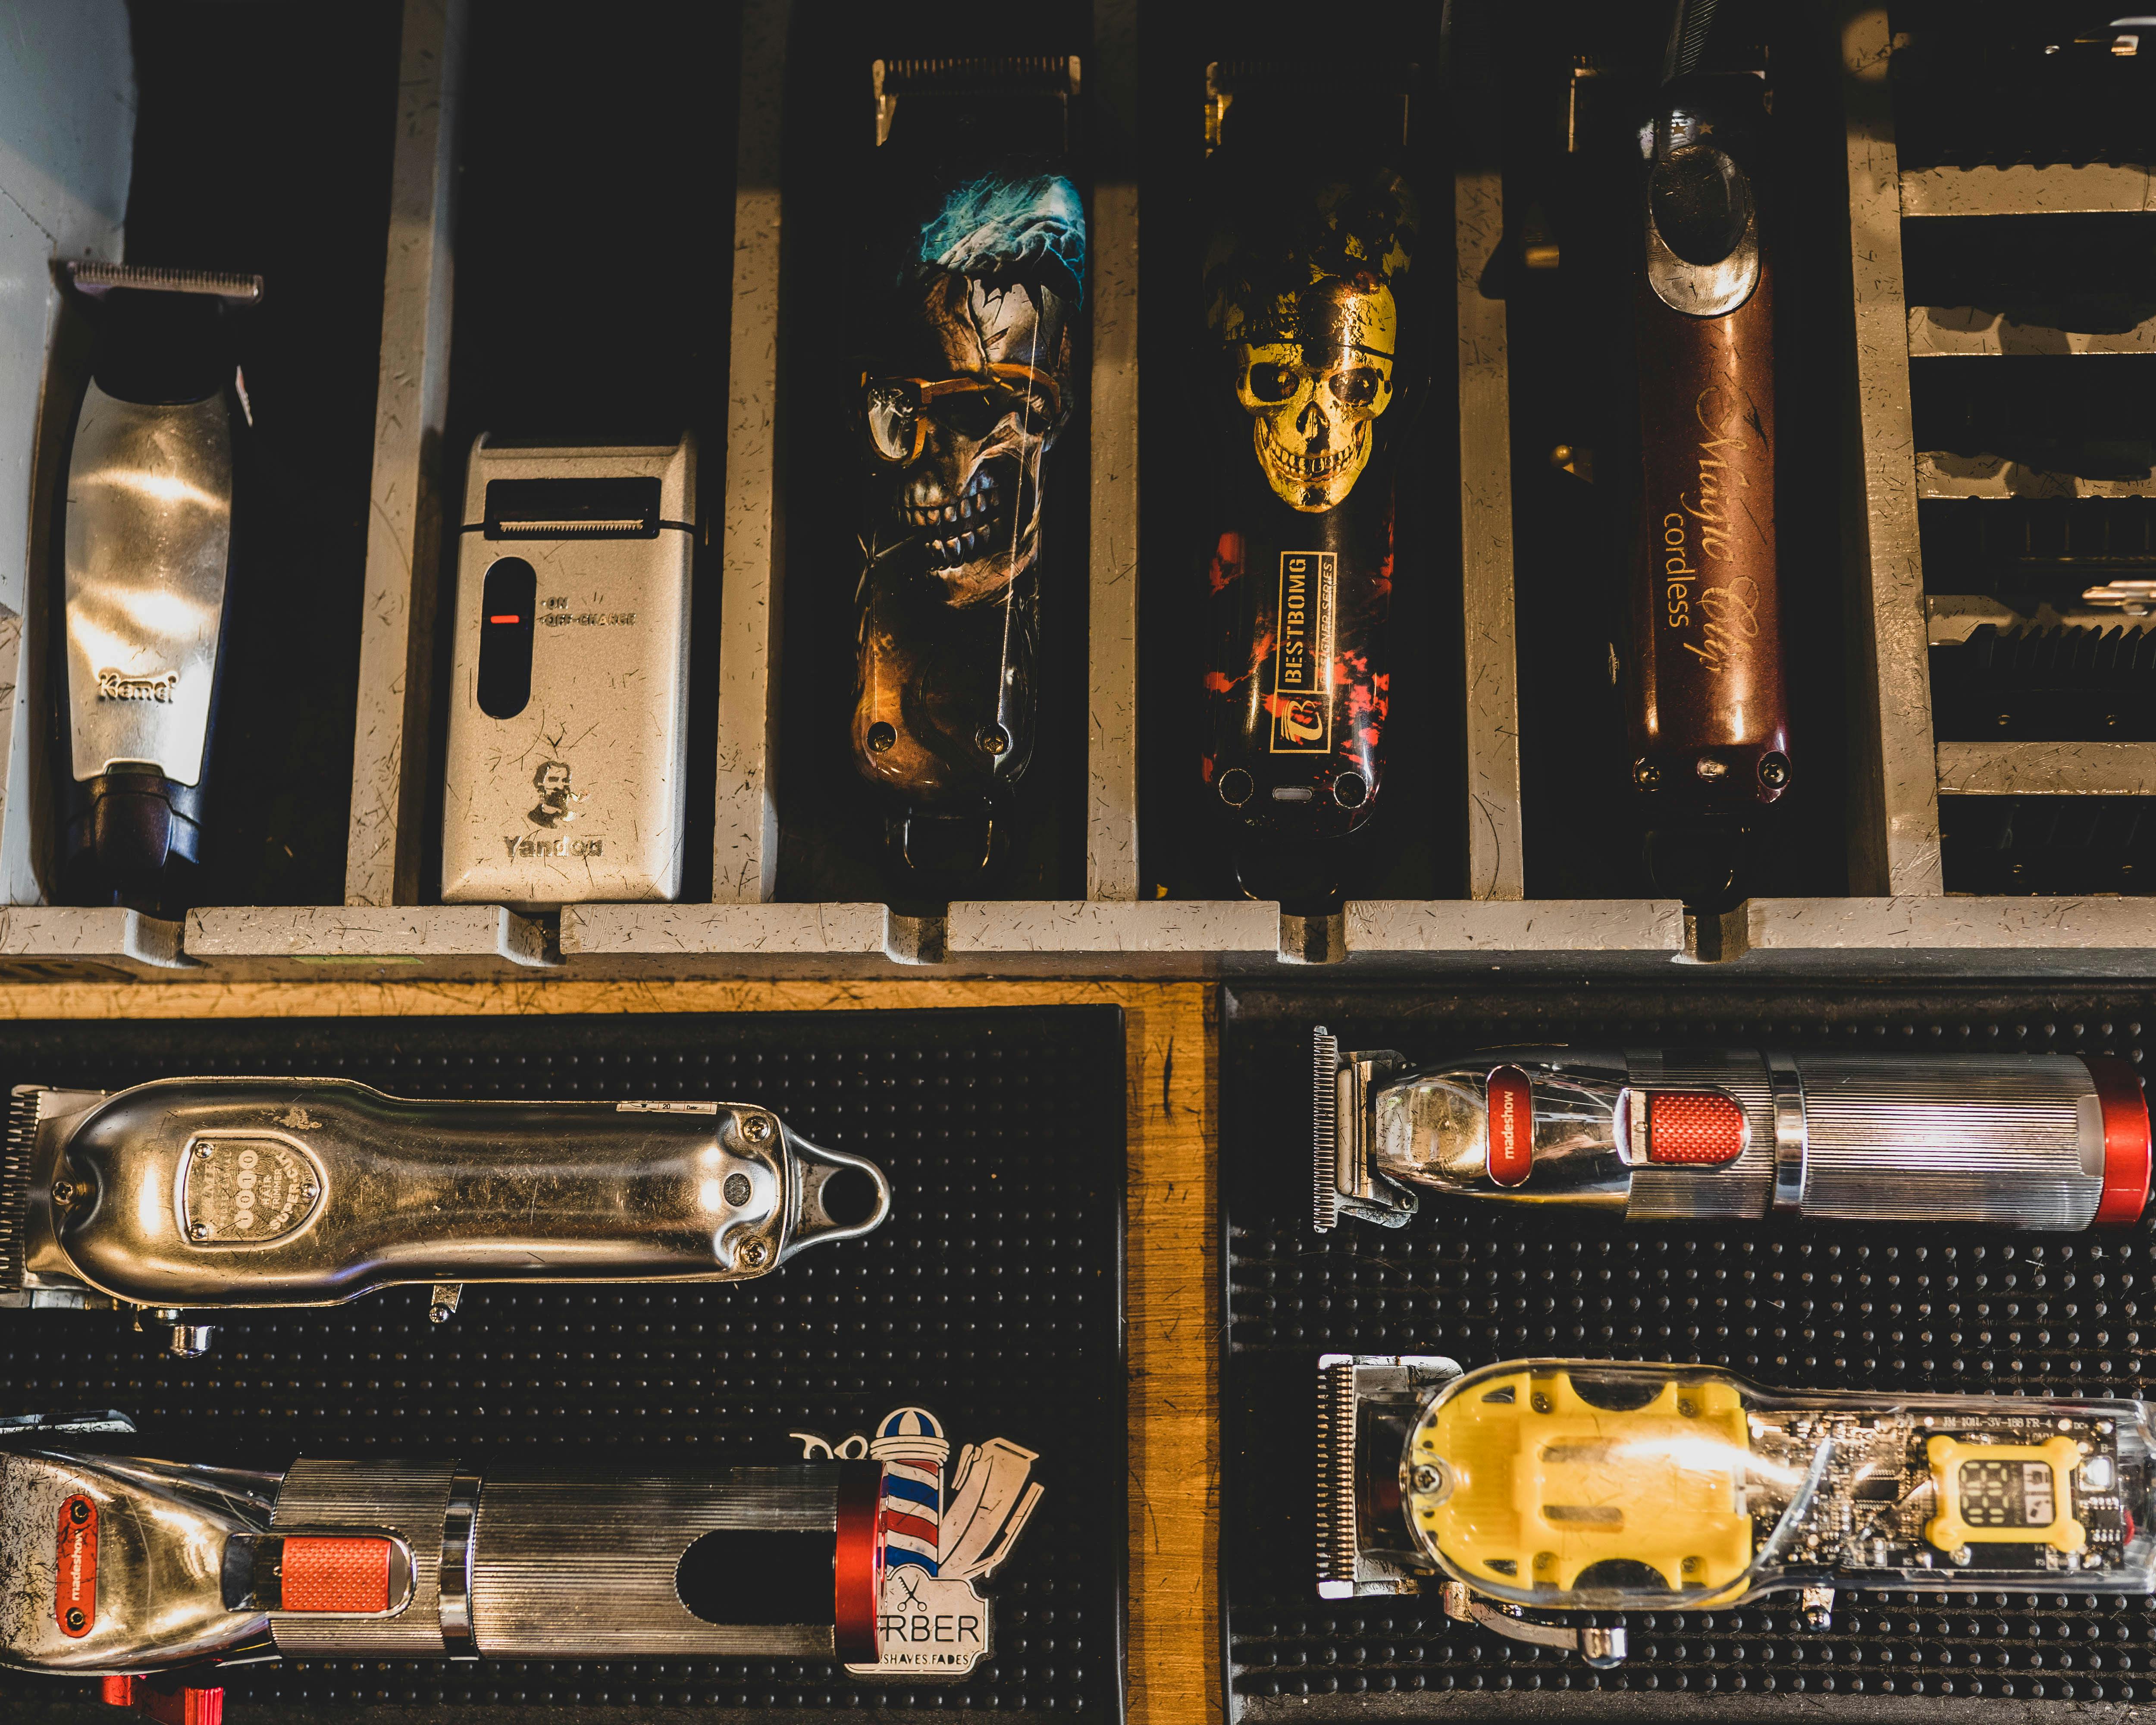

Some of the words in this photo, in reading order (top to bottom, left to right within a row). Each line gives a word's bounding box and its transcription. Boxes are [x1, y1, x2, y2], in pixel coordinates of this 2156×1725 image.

[1680, 386, 1751, 563] Magic
[1664, 513, 1696, 628] cordless
[546, 596, 568, 610] ON
[1285, 559, 1306, 683] BESTBOMG
[97, 673, 177, 704] Kemei
[1500, 1091, 1514, 1160] madeshow
[261, 1175, 272, 1205] HAIR
[272, 1168, 282, 1210] TRIMMER
[70, 1530, 83, 1601] madeshow
[877, 1615, 980, 1643] RBER
